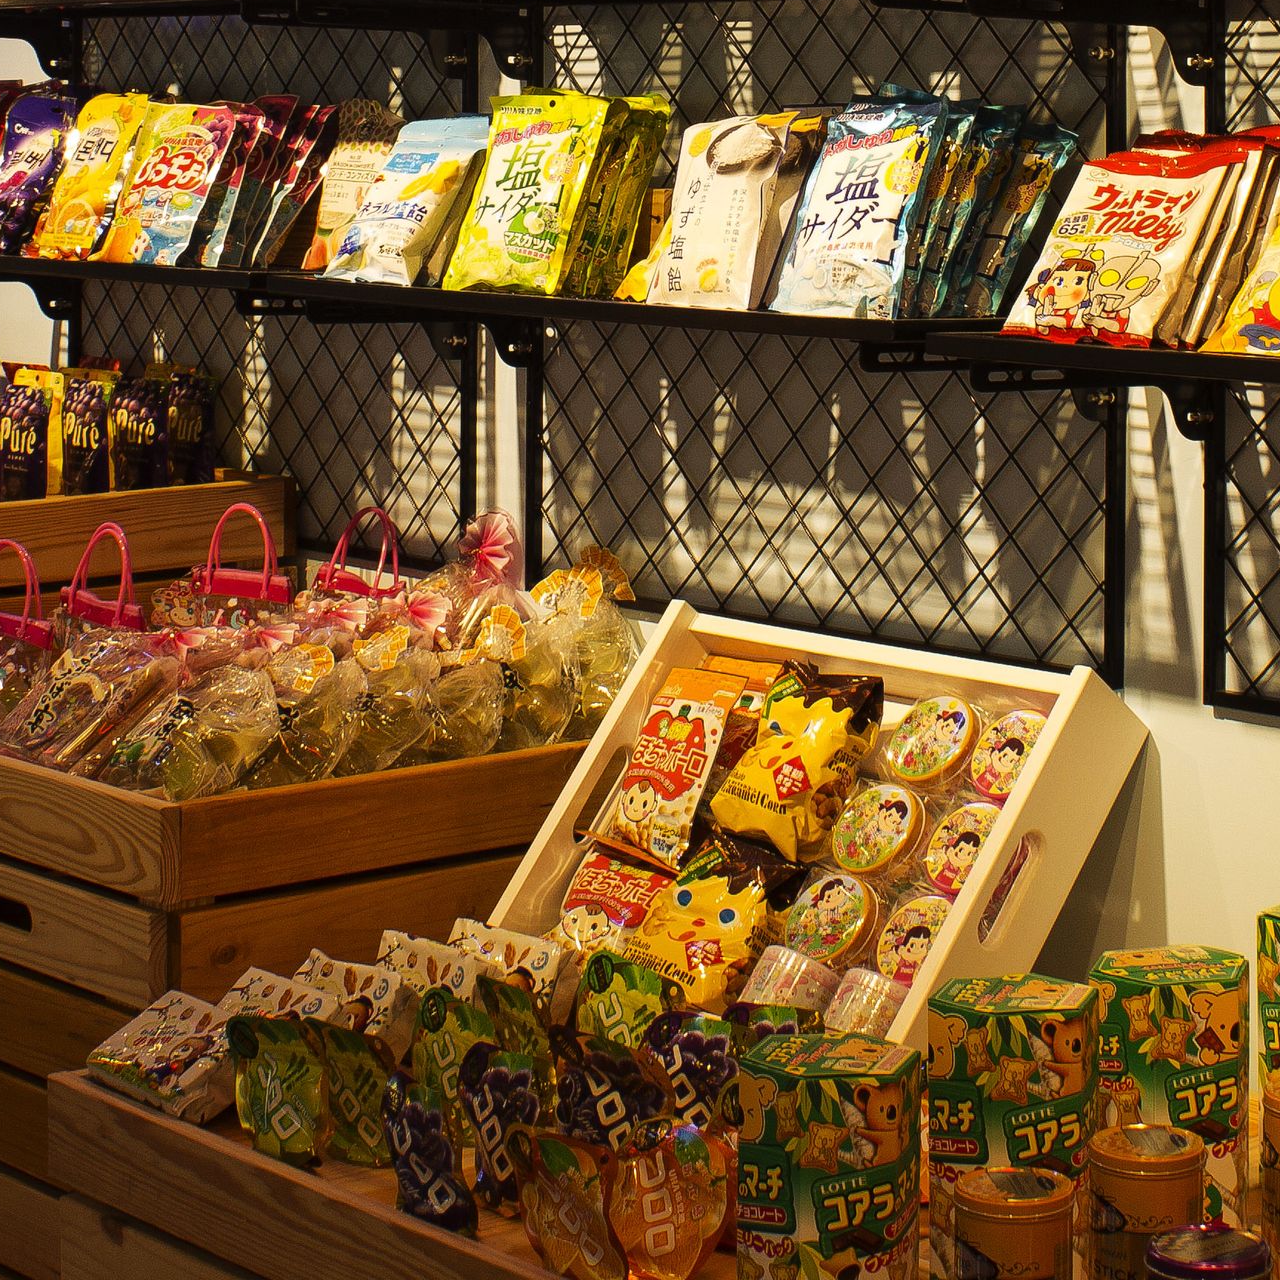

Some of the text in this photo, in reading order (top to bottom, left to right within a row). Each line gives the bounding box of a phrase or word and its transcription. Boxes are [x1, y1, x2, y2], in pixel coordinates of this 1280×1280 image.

[496, 140, 552, 192] 塩
[826, 152, 894, 205] 塩
[504, 231, 556, 252] マスカット
[63, 411, 100, 450] Puré
[114, 408, 155, 446] Puré
[760, 794, 787, 815] Corn
[663, 960, 697, 988] Corn
[1172, 1070, 1214, 1088] LOTTE
[1011, 1105, 1056, 1126] LOTTE
[820, 1175, 867, 1194] LOTTE
